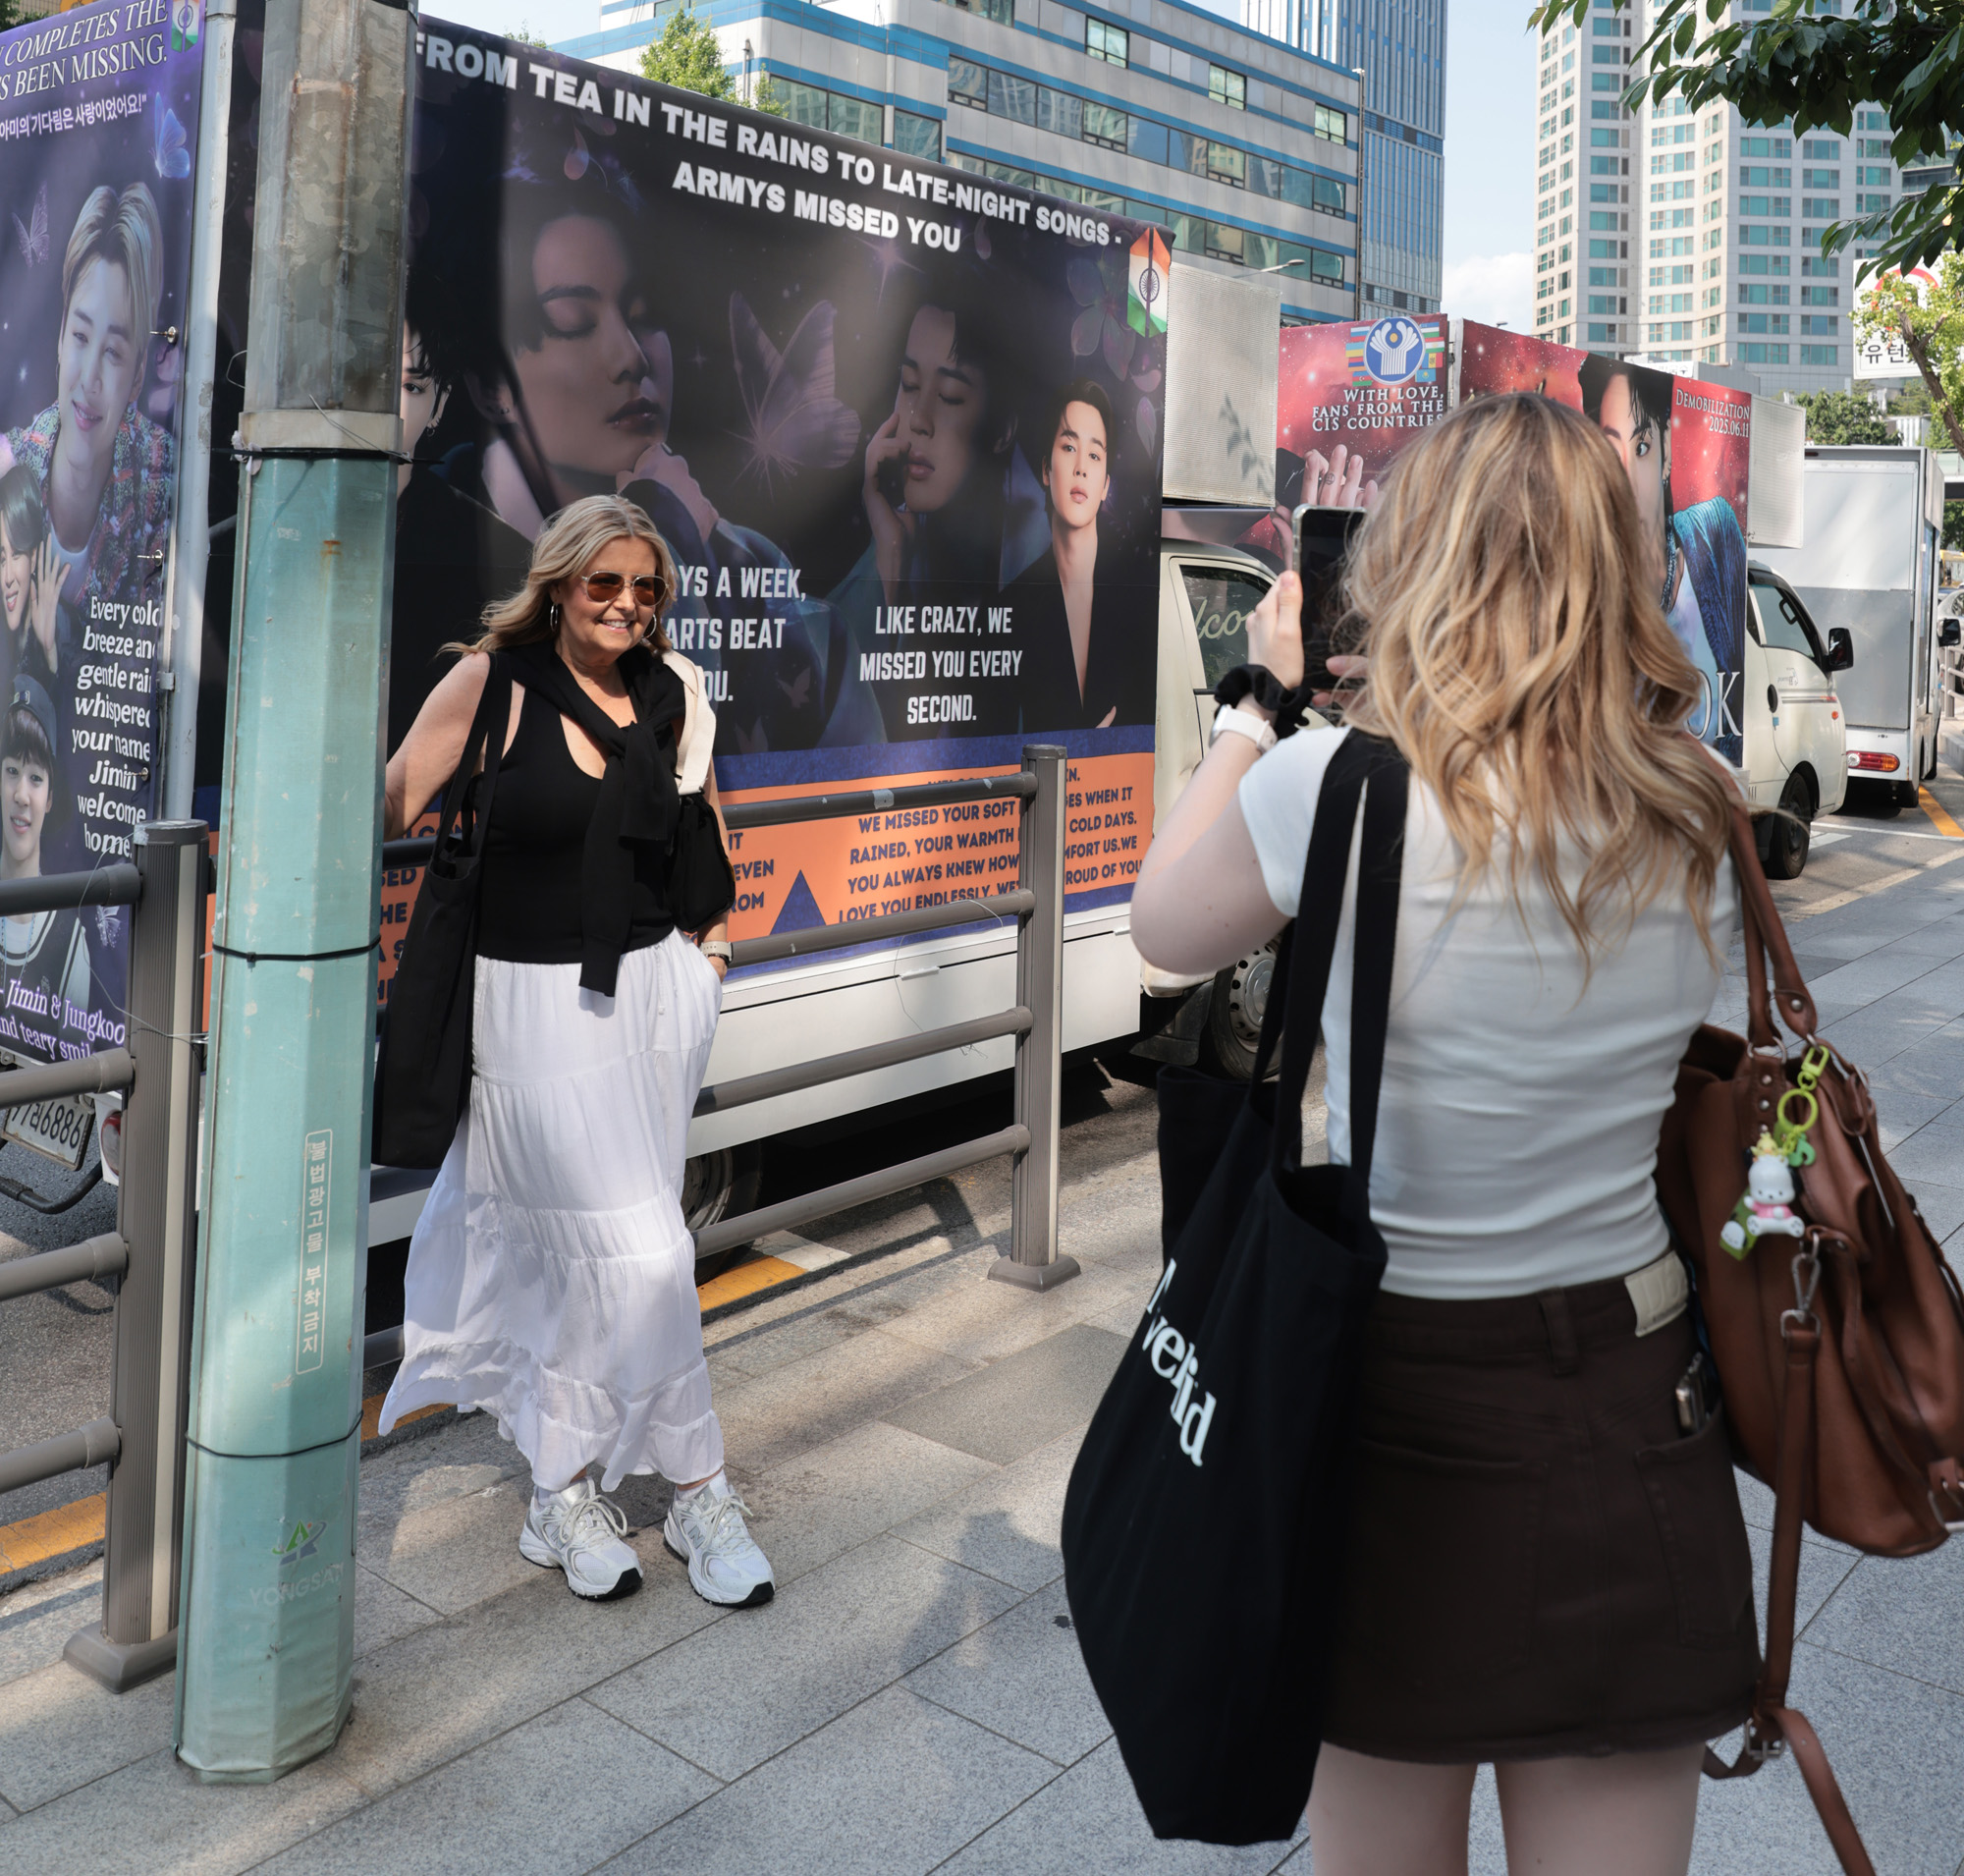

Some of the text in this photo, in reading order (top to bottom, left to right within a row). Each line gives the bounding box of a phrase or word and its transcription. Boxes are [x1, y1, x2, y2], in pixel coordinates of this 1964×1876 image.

[5, 0, 168, 67] COMPLETES THE
[14, 59, 67, 96] BEEN
[71, 32, 167, 83] MISSING.
[528, 62, 604, 115] TEA
[614, 87, 651, 128] IN
[660, 101, 728, 148] THE
[736, 124, 829, 174] RAINS
[837, 150, 875, 186] TO
[883, 163, 1031, 226] LATE-NIGHT
[1036, 206, 1111, 246] SONGS
[672, 160, 961, 252] ARMYS MISSED YOU
[1312, 400, 1444, 418] FANS FROM THE
[1343, 386, 1444, 402] WITH LOVE,
[1676, 388, 1750, 419] DEMOBILIZATION
[1312, 414, 1444, 431] CIS COUNTRIES
[1709, 415, 1749, 437] 2025.06.11
[715, 567, 732, 598] A
[740, 567, 806, 602] WEEK,
[90, 595, 130, 630] Every
[875, 606, 1013, 636] LIKE CRAZY, WE
[82, 625, 155, 659] breeze an
[666, 618, 787, 649] ARTS BEAT
[77, 662, 128, 690] gentle
[859, 650, 1023, 682] MISSED YOU EVERY
[906, 694, 977, 725] SECOND.
[72, 728, 150, 761] your name
[89, 760, 136, 791] Jimin
[78, 792, 146, 826] welcome
[858, 787, 1133, 833] WE MISSED YOUR SOFT ES WHEN IT
[849, 811, 1137, 864] RAINED, YOUR WARMTH COLD DAYS.
[847, 873, 879, 894] YOU
[883, 864, 942, 888] ALWAYS
[946, 858, 985, 878] KNEW
[989, 854, 1020, 871] HOW
[839, 903, 877, 924] LOVE
[881, 892, 910, 913] YOU
[1101, 863, 1117, 878] OF
[6, 978, 47, 1015] Jimin
[51, 993, 61, 1019] &
[20, 1022, 56, 1060] teary
[59, 1041, 95, 1061] smil
[302, 1140, 327, 1354] 불법광고물 부착금지
